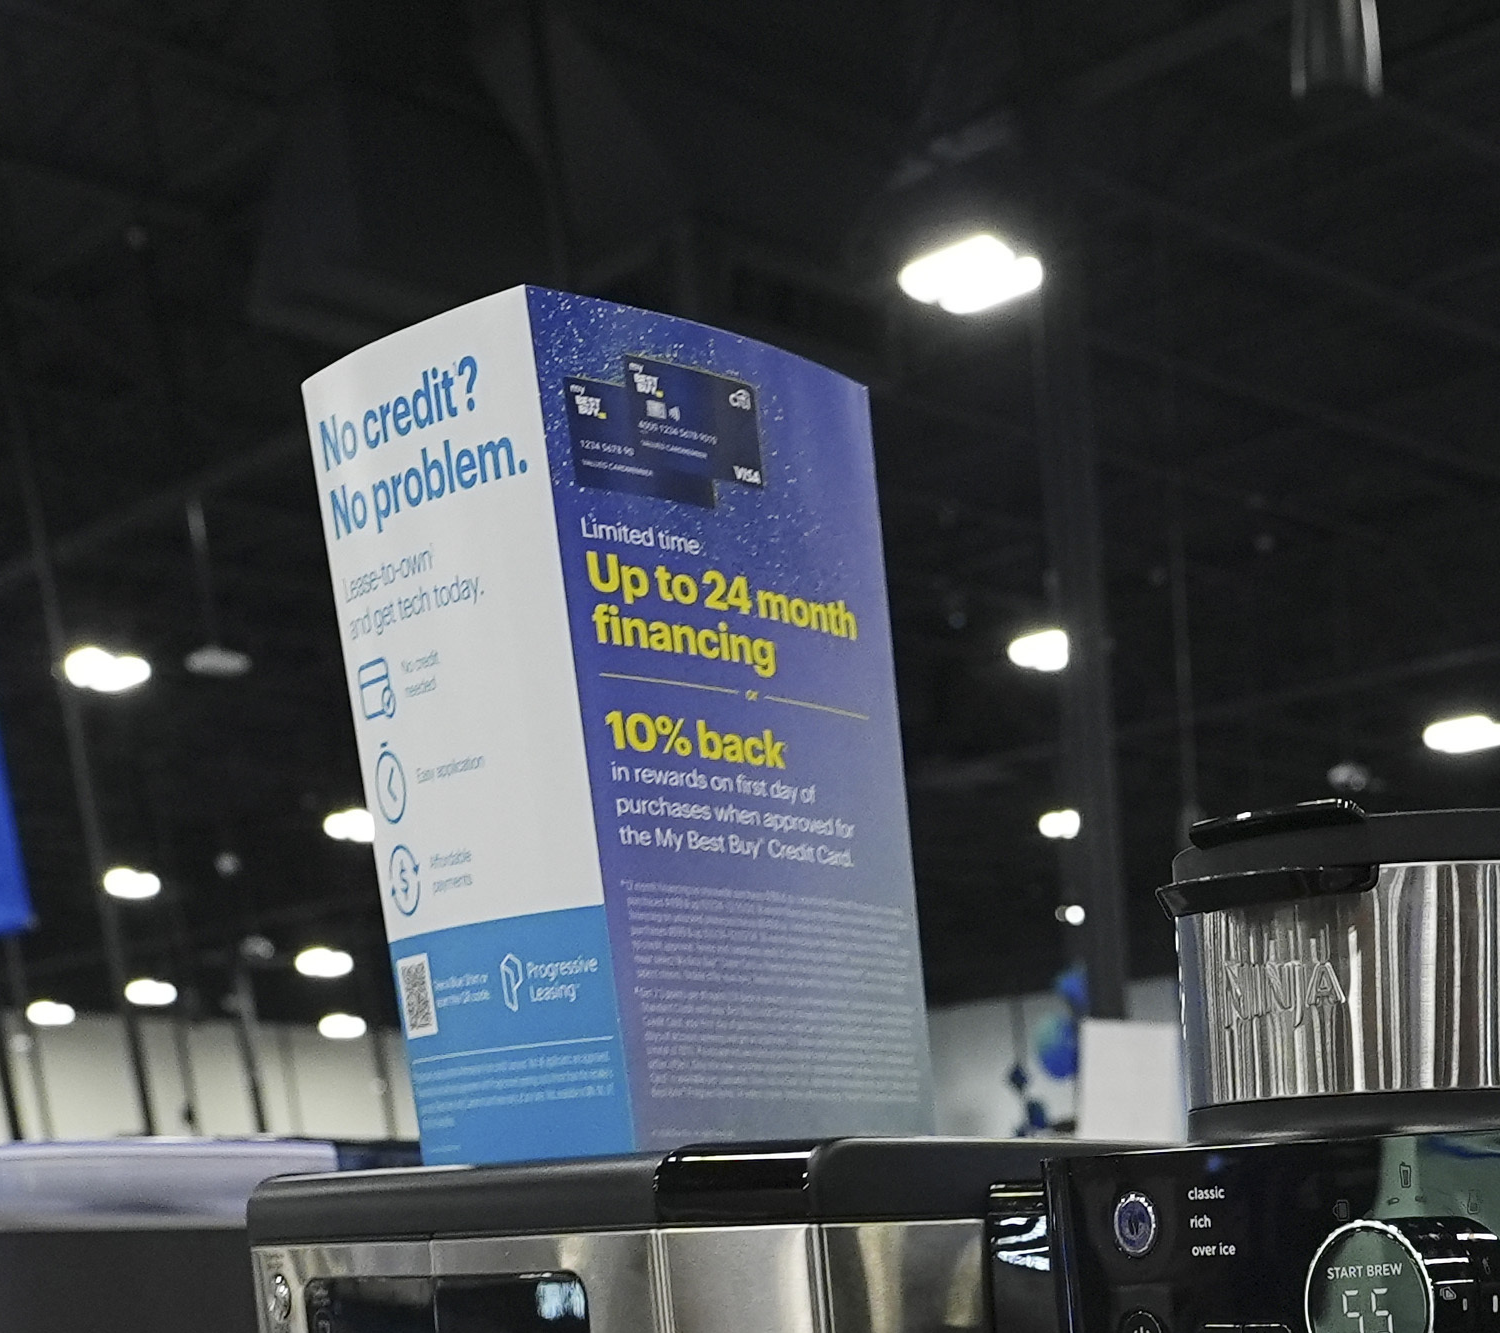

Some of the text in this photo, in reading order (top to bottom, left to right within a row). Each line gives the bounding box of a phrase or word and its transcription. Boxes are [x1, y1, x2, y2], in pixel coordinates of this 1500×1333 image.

[319, 356, 478, 472] No credit?
[330, 436, 527, 540] No problem.
[733, 465, 762, 485] VISA
[580, 516, 700, 555] Limited time
[350, 575, 484, 640] and get tech today.
[586, 551, 858, 641] Up to 24 month
[592, 603, 777, 678] financing
[605, 710, 786, 769] 10% back
[611, 761, 816, 805] in rewards on first day of
[616, 796, 855, 839] purchases when approved for
[619, 825, 651, 848] the
[655, 827, 683, 852] My
[687, 830, 725, 854] Best
[767, 838, 816, 863] Credit
[526, 954, 598, 981] Progressive
[1188, 1186, 1225, 1200] classic
[1190, 1214, 1211, 1228] rich
[1192, 1243, 1236, 1257] over ice
[1327, 1263, 1402, 1280] START BREW
